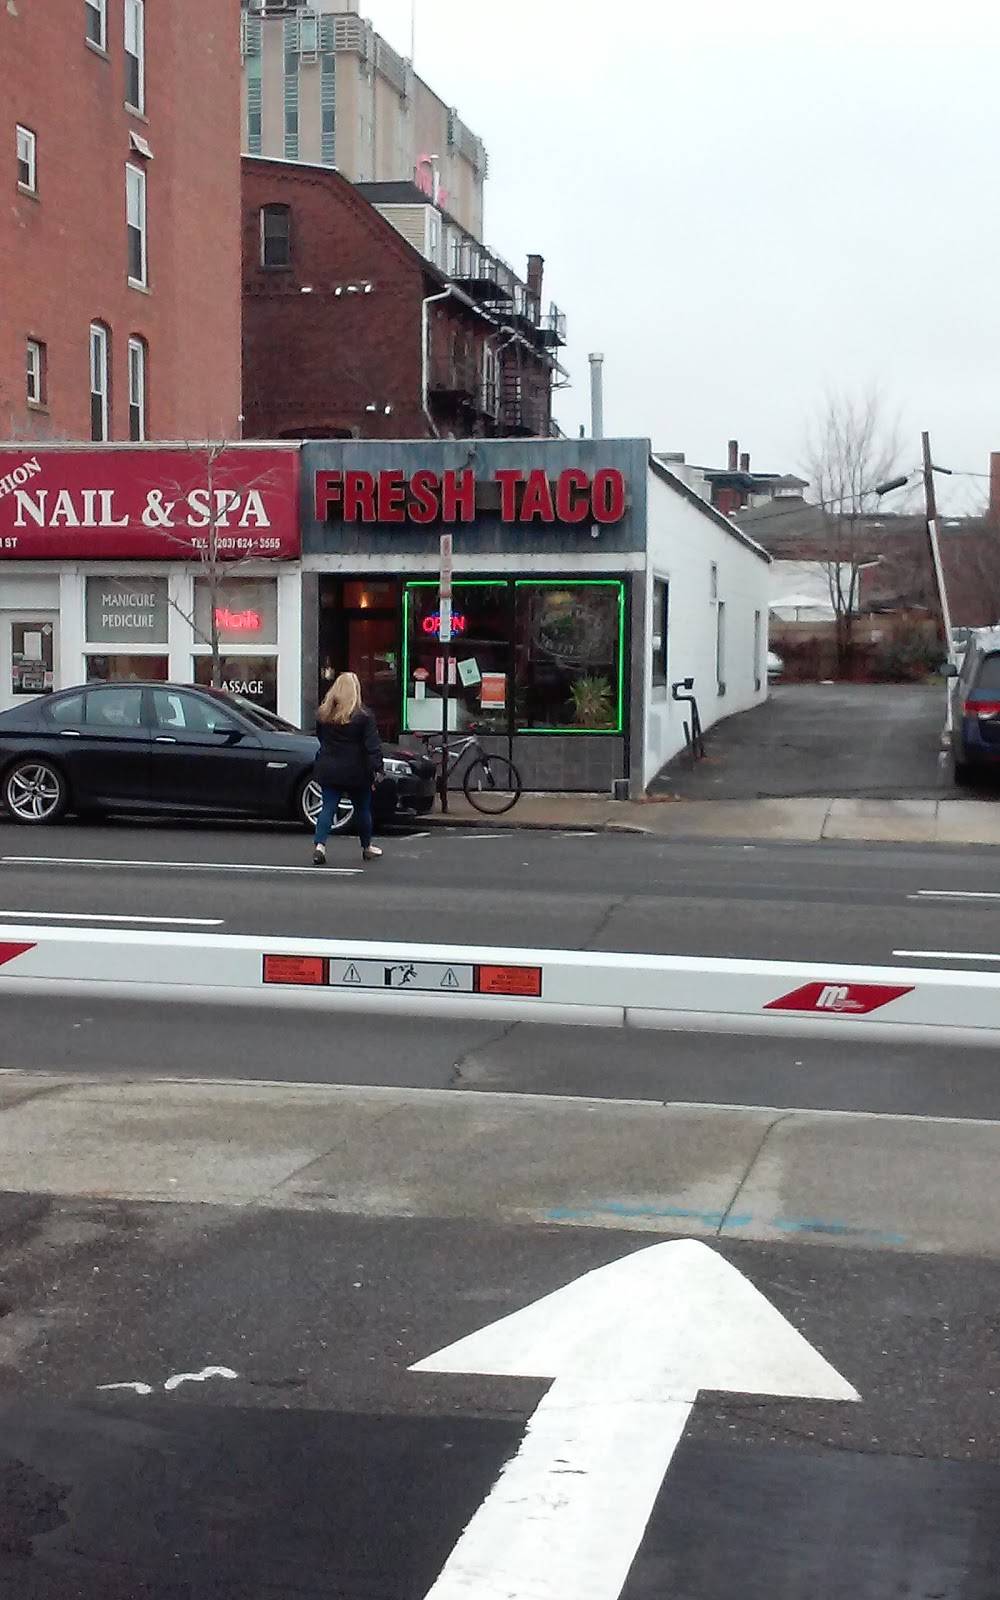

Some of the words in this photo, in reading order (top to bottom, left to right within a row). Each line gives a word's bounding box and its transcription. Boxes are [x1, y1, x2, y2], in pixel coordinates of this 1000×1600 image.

[314, 468, 476, 523] FRESH
[495, 467, 626, 523] TACO
[13, 489, 129, 527] NAIL
[141, 489, 175, 527] &
[187, 489, 271, 527] SPA
[4, 537, 18, 548] ST
[102, 593, 156, 608] MANICURE
[102, 614, 155, 628] PEDICURE
[214, 607, 260, 629] Nails
[210, 680, 264, 694] ASSAGE
